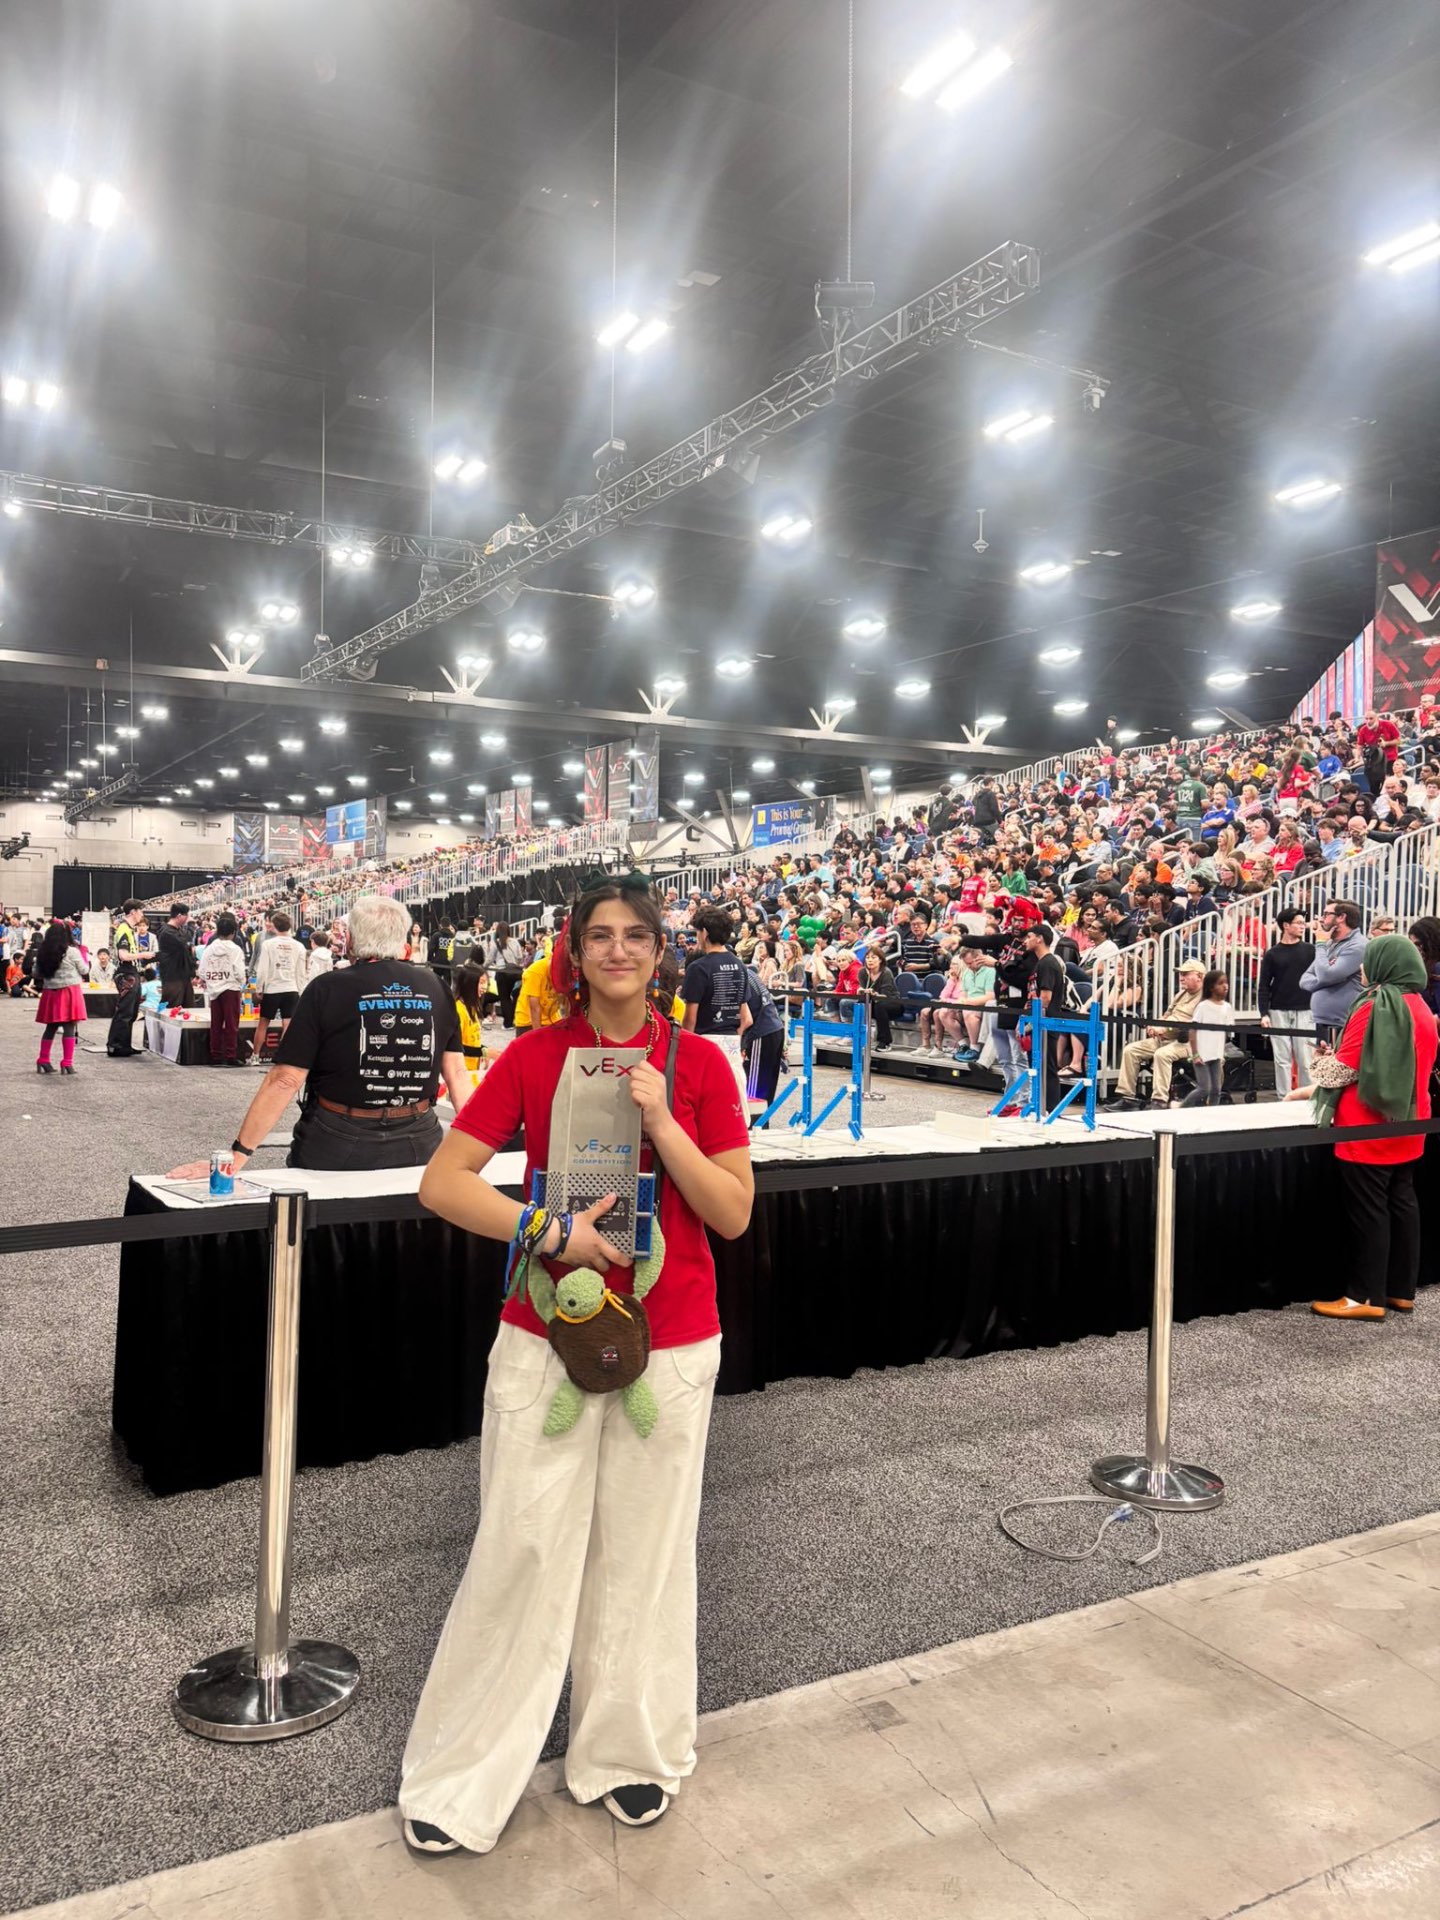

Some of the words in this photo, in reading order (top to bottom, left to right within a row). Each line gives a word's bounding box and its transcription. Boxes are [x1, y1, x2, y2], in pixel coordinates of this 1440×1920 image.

[609, 756, 631, 774] VEX
[771, 808, 782, 821] This
[783, 807, 789, 820] is
[789, 806, 803, 819] Your
[270, 824, 298, 835] VEX
[770, 823, 793, 838] Proving
[382, 982, 412, 992] VEX
[358, 999, 401, 1012] EVENT
[401, 1016, 424, 1026] Google
[580, 1057, 636, 1077] VEX
[574, 1139, 612, 1153] VEX
[615, 1144, 632, 1154] IQ
